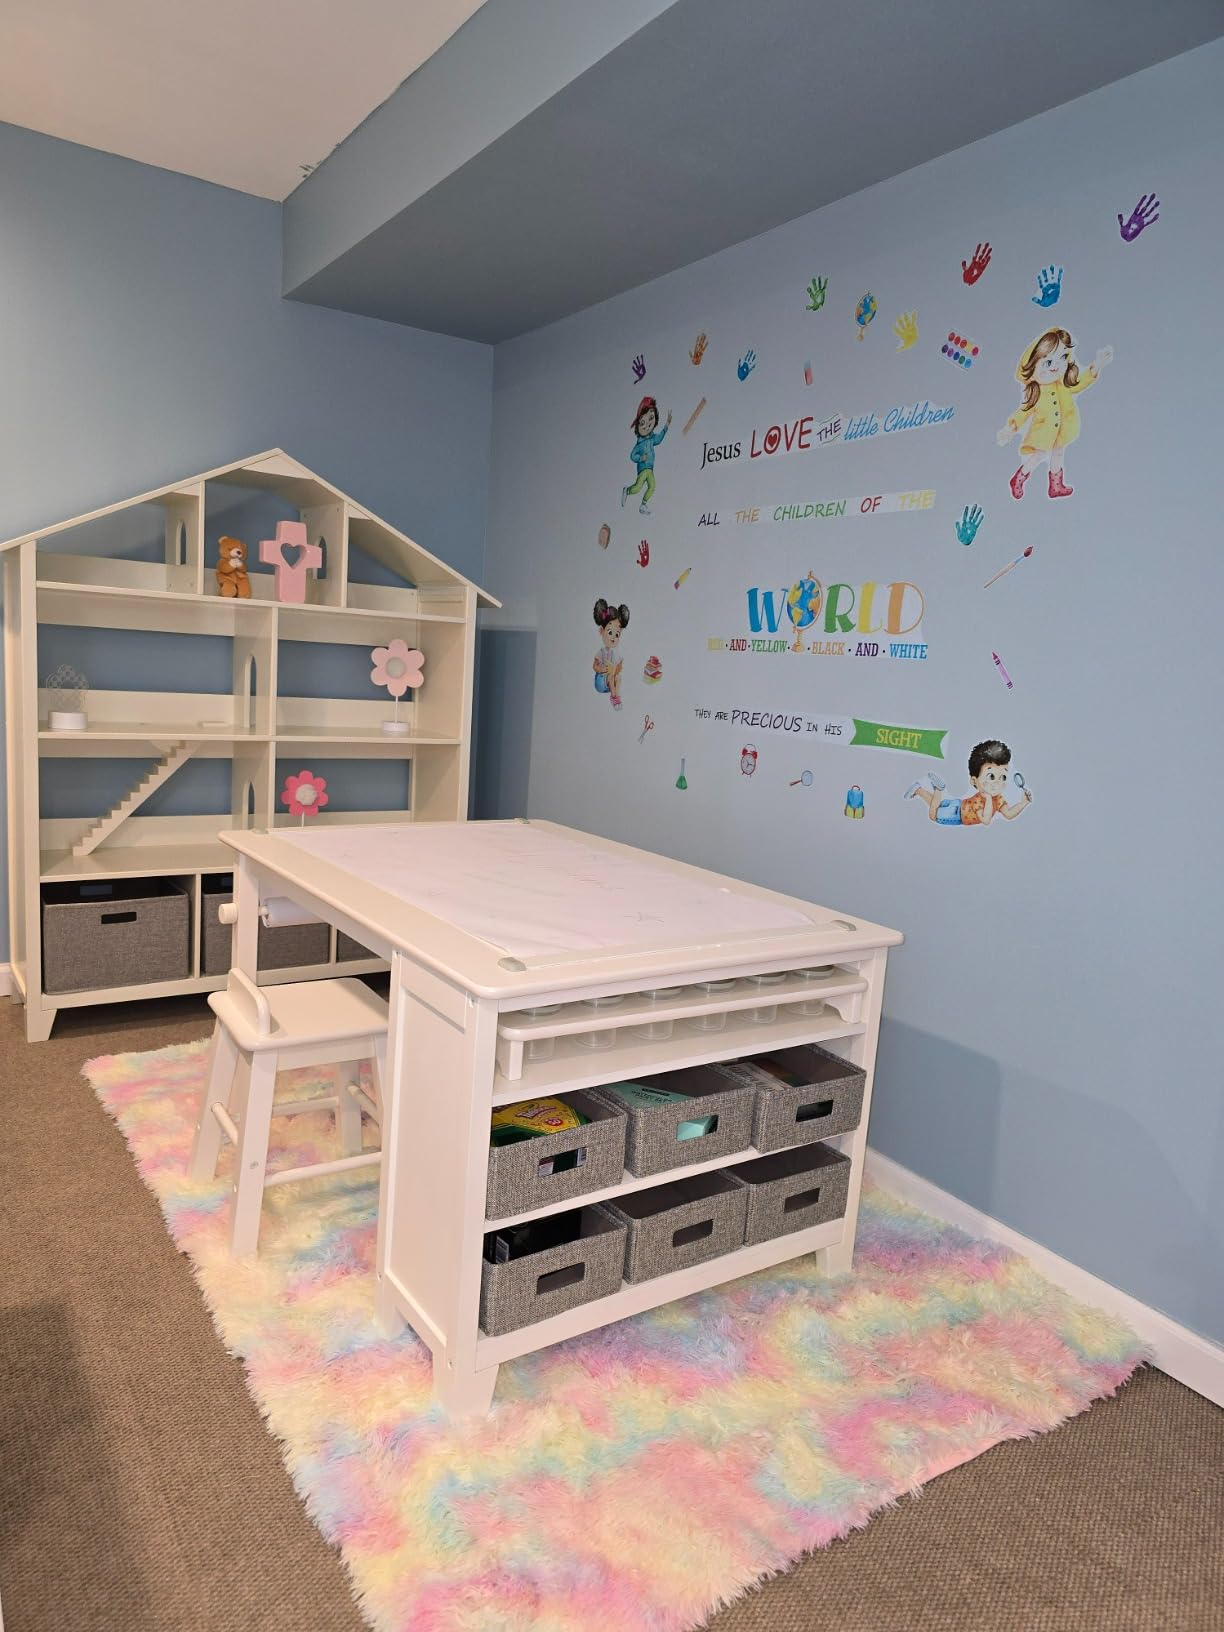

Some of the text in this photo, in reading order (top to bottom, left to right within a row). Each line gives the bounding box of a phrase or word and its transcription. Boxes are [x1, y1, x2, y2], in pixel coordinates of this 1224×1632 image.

[700, 400, 954, 470] Jesus LOVE THE little Children
[698, 490, 936, 526] ALL THE CHILDREN OF THE
[855, 643, 879, 657] AND
[889, 643, 928, 659] WHITE
[694, 708, 922, 749] THEY ARE PRECIOUS IN HIS SIGHT
